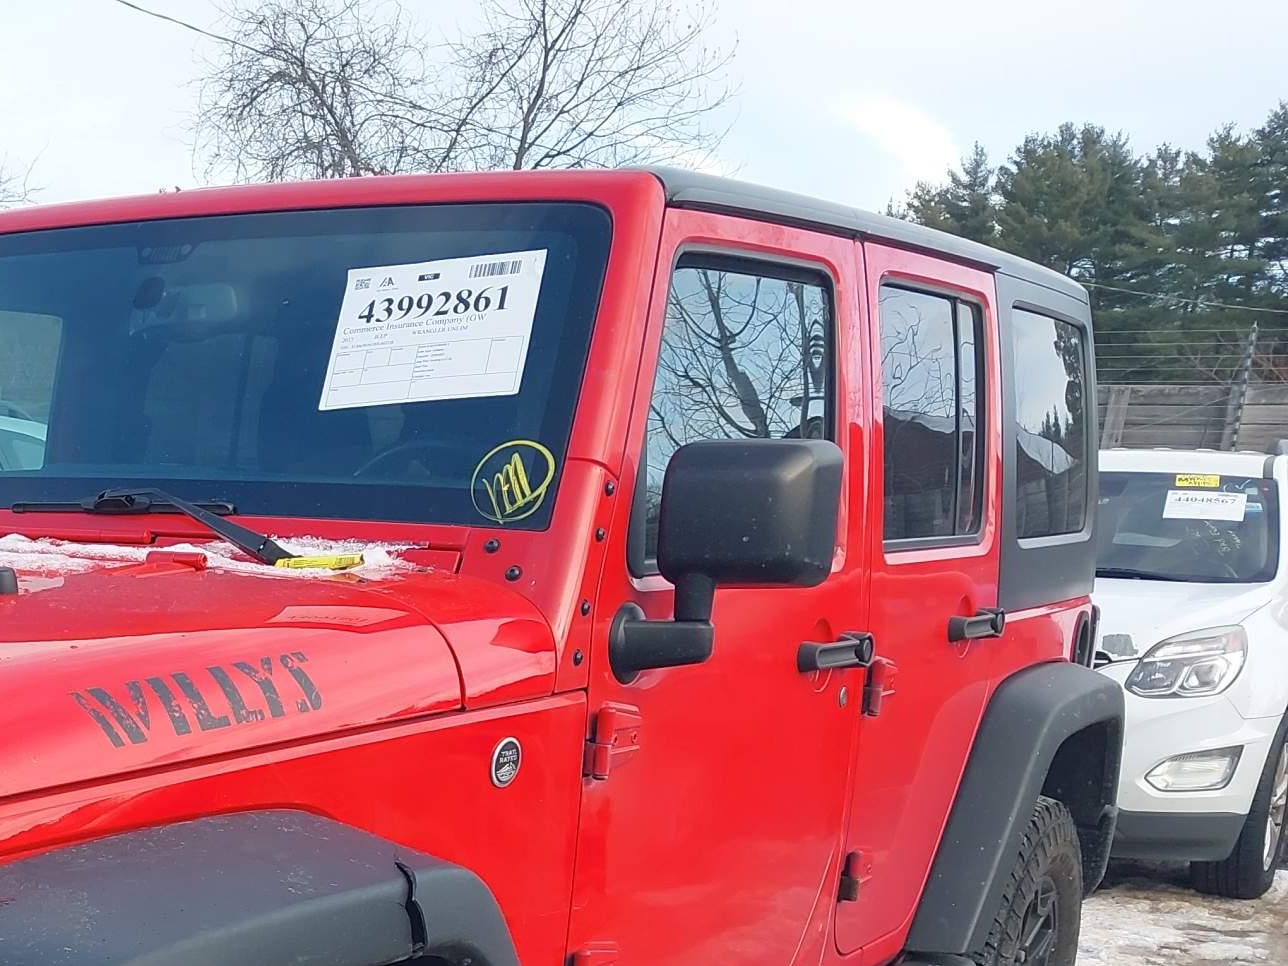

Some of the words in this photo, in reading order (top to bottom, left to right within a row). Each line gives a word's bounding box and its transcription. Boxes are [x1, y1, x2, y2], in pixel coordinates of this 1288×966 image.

[357, 285, 510, 324] 43992861
[343, 325, 384, 335] Commerce
[386, 320, 424, 331] Insurance
[426, 315, 464, 327] Company
[70, 651, 323, 748] WILLYS
